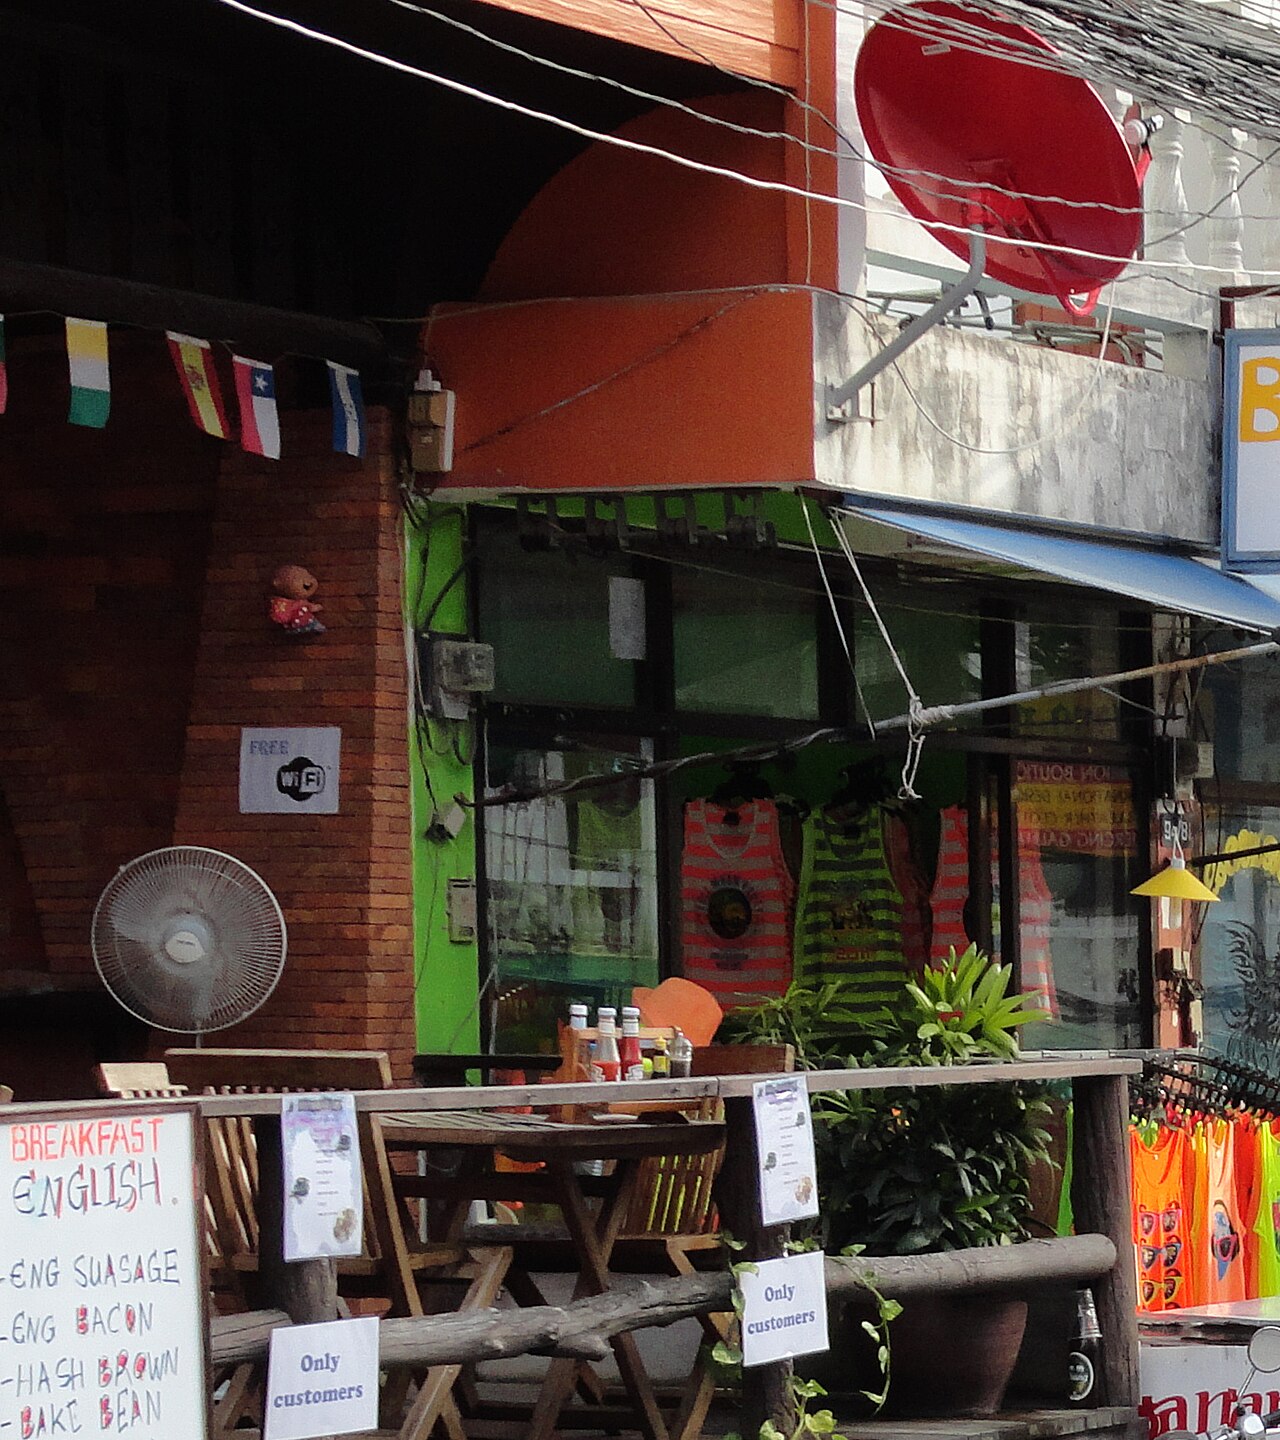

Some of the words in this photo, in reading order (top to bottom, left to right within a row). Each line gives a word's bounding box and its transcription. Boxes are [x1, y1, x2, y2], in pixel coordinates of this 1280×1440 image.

[250, 740, 289, 756] FREE
[9, 1118, 165, 1162] BREAKFAST
[74, 1249, 181, 1288] SUASAGE
[764, 1282, 796, 1303] Only
[75, 1302, 153, 1335] BACON
[747, 1310, 816, 1336] customers
[98, 1347, 179, 1388] BROWN
[301, 1352, 341, 1373] Only
[274, 1384, 364, 1409] customers
[99, 1389, 161, 1434] BEAN
